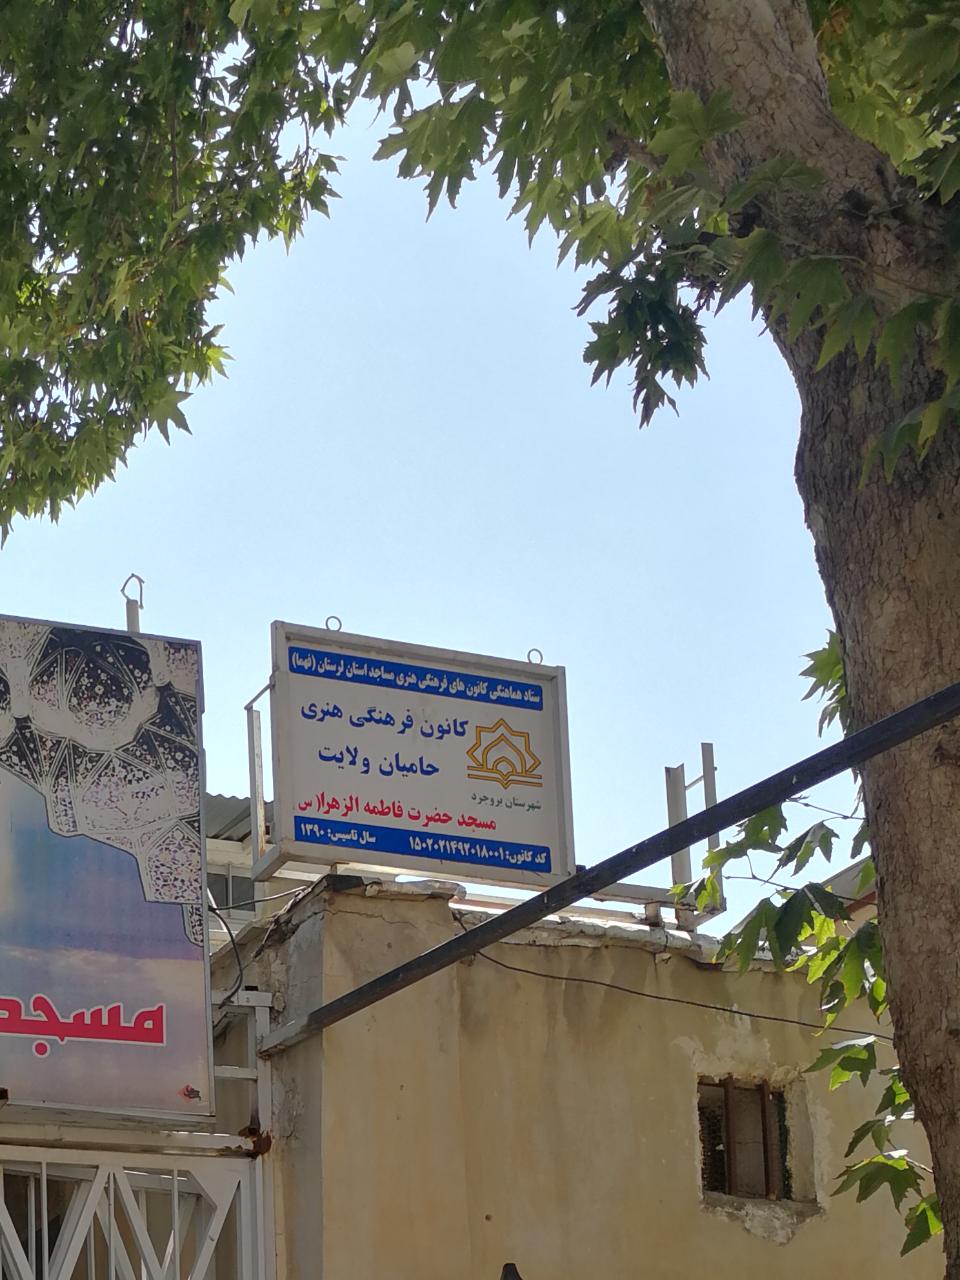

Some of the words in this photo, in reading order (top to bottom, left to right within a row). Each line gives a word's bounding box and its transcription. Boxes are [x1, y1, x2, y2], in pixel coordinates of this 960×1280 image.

[317, 657, 344, 676] لرستان
[346, 661, 368, 678] استان
[369, 666, 395, 682] مساجد
[396, 671, 417, 686] هنری
[418, 673, 448, 692] فرهنگی
[449, 678, 465, 694] های
[466, 681, 488, 697] کانون
[301, 702, 343, 722] هنری
[349, 706, 414, 734] فرهنگی
[420, 718, 468, 740] کانون
[318, 745, 371, 774] ولایت
[379, 752, 440, 778] حامیان
[364, 799, 403, 818] فاطمه
[471, 792, 503, 807] بروجرد
[505, 796, 542, 812] شهرستان
[407, 807, 453, 827] حضرت
[457, 813, 497, 832] مسجد
[359, 830, 376, 844] سال
